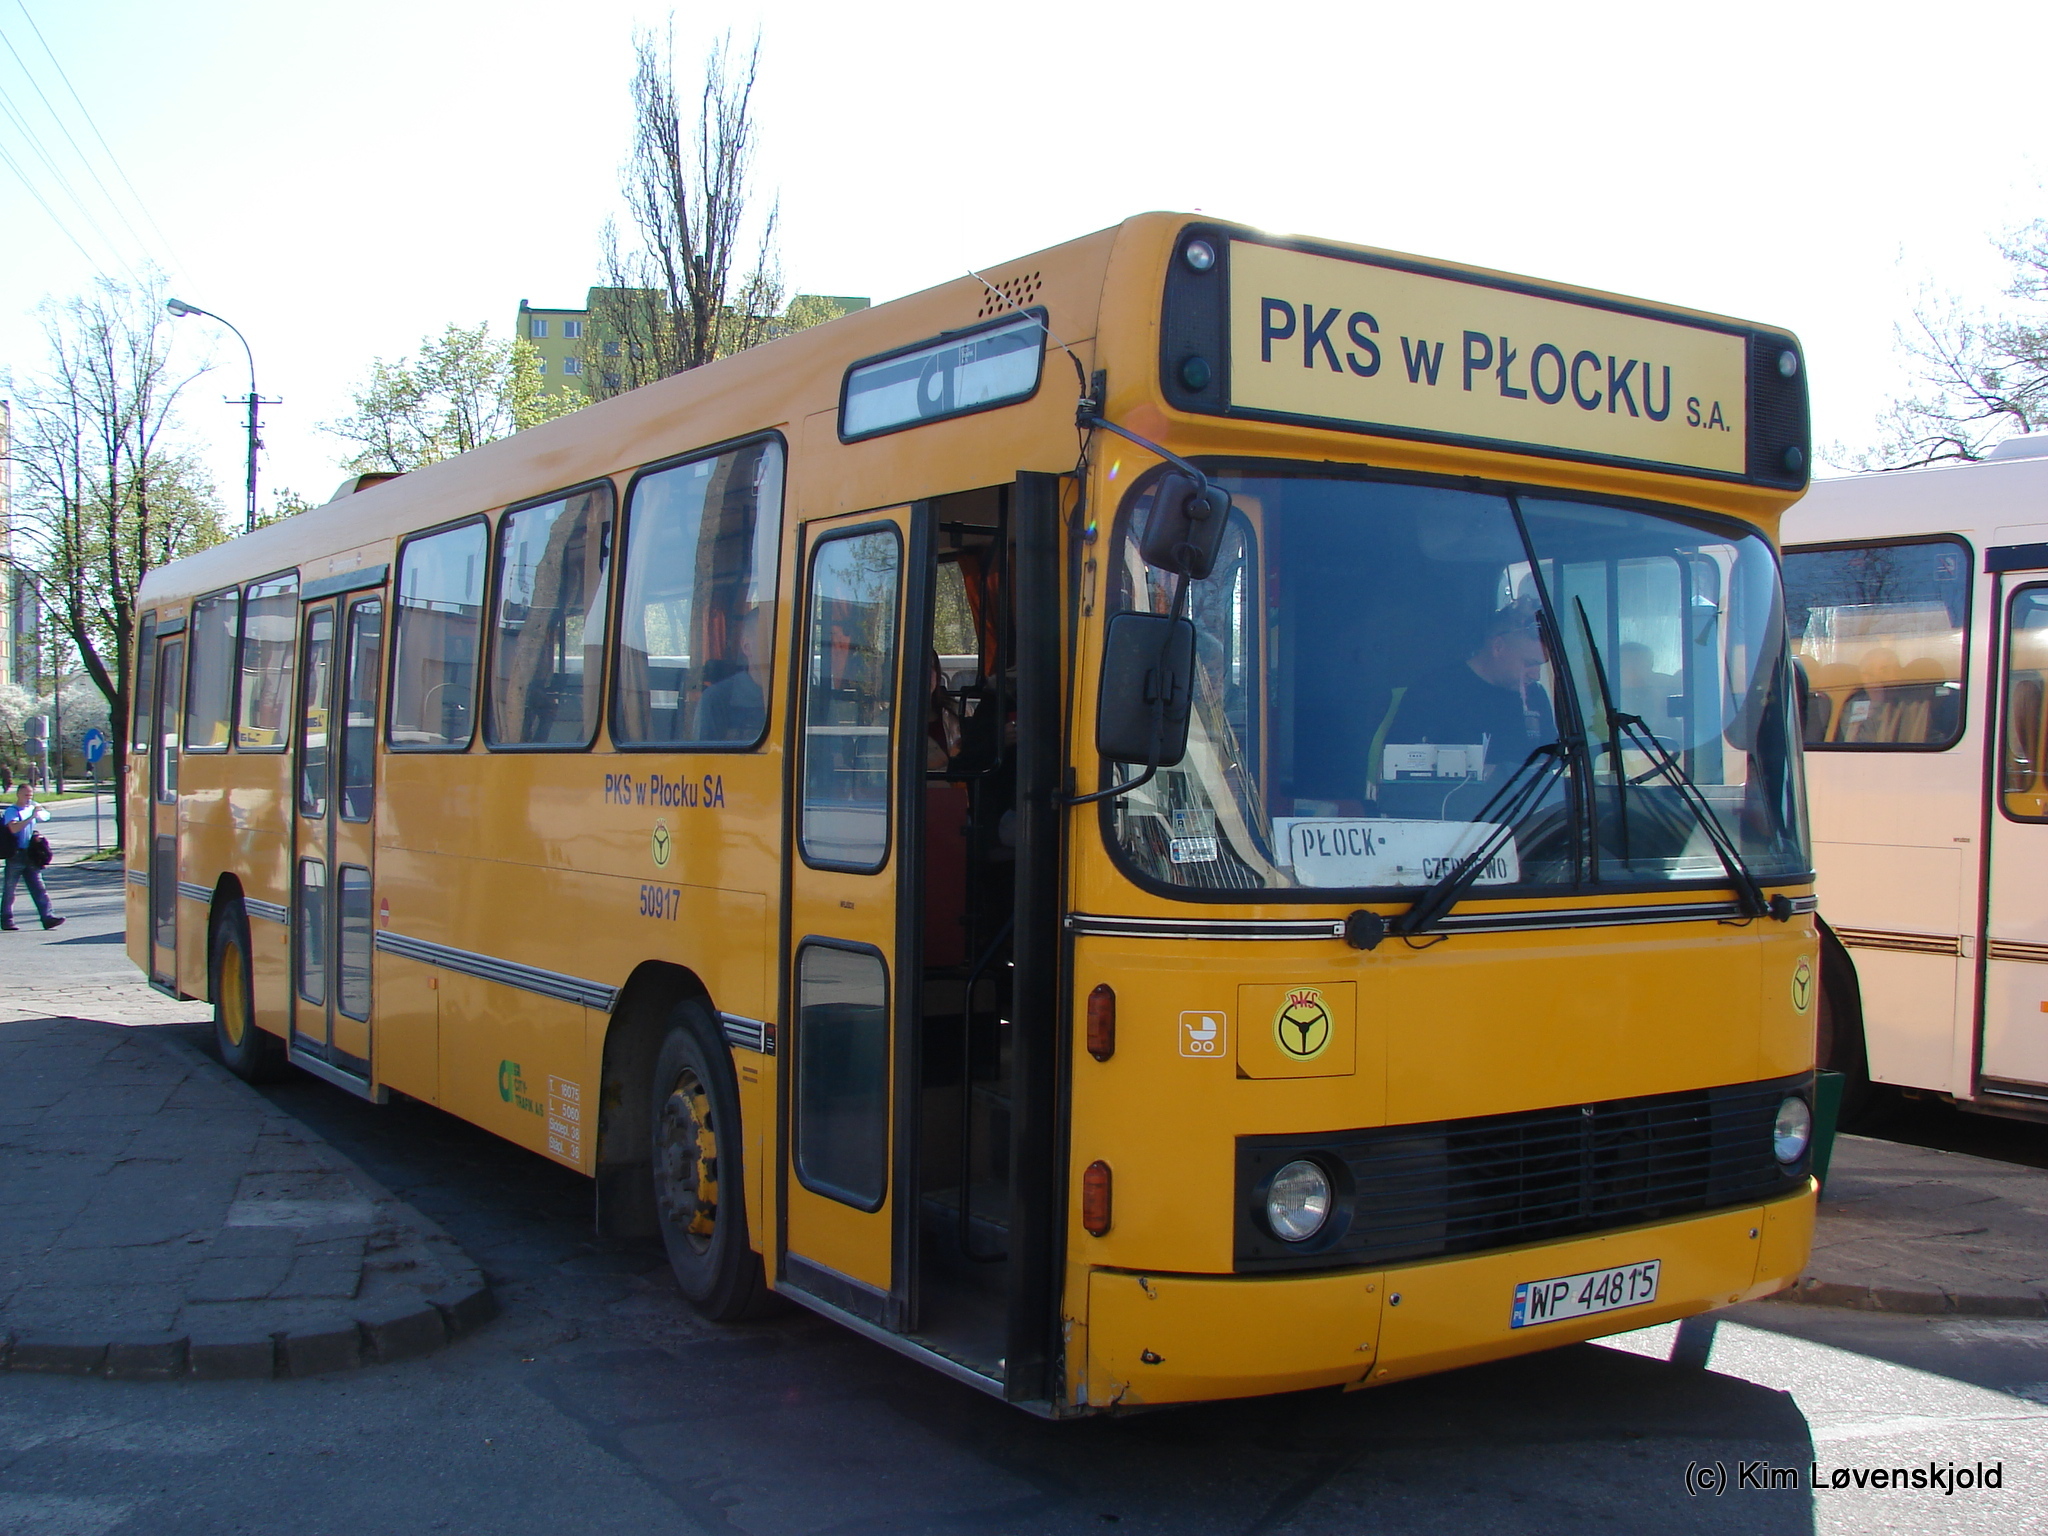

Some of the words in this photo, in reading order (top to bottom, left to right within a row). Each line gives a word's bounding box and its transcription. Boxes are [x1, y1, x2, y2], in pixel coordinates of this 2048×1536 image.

[1261, 297, 1382, 377] PKS
[1400, 336, 1444, 386] w
[1462, 330, 1671, 422] PŁOCKU
[1686, 397, 1731, 432] S.A.
[605, 773, 631, 804] PKS
[635, 782, 647, 805] w
[650, 774, 698, 808] Płocku
[703, 774, 725, 809] SA
[640, 884, 681, 922] 50917
[1290, 991, 1318, 1010] PKS
[1531, 1282, 1569, 1319] WP
[1578, 1265, 1655, 1310] 44815
[1513, 1311, 1523, 1320] PL
